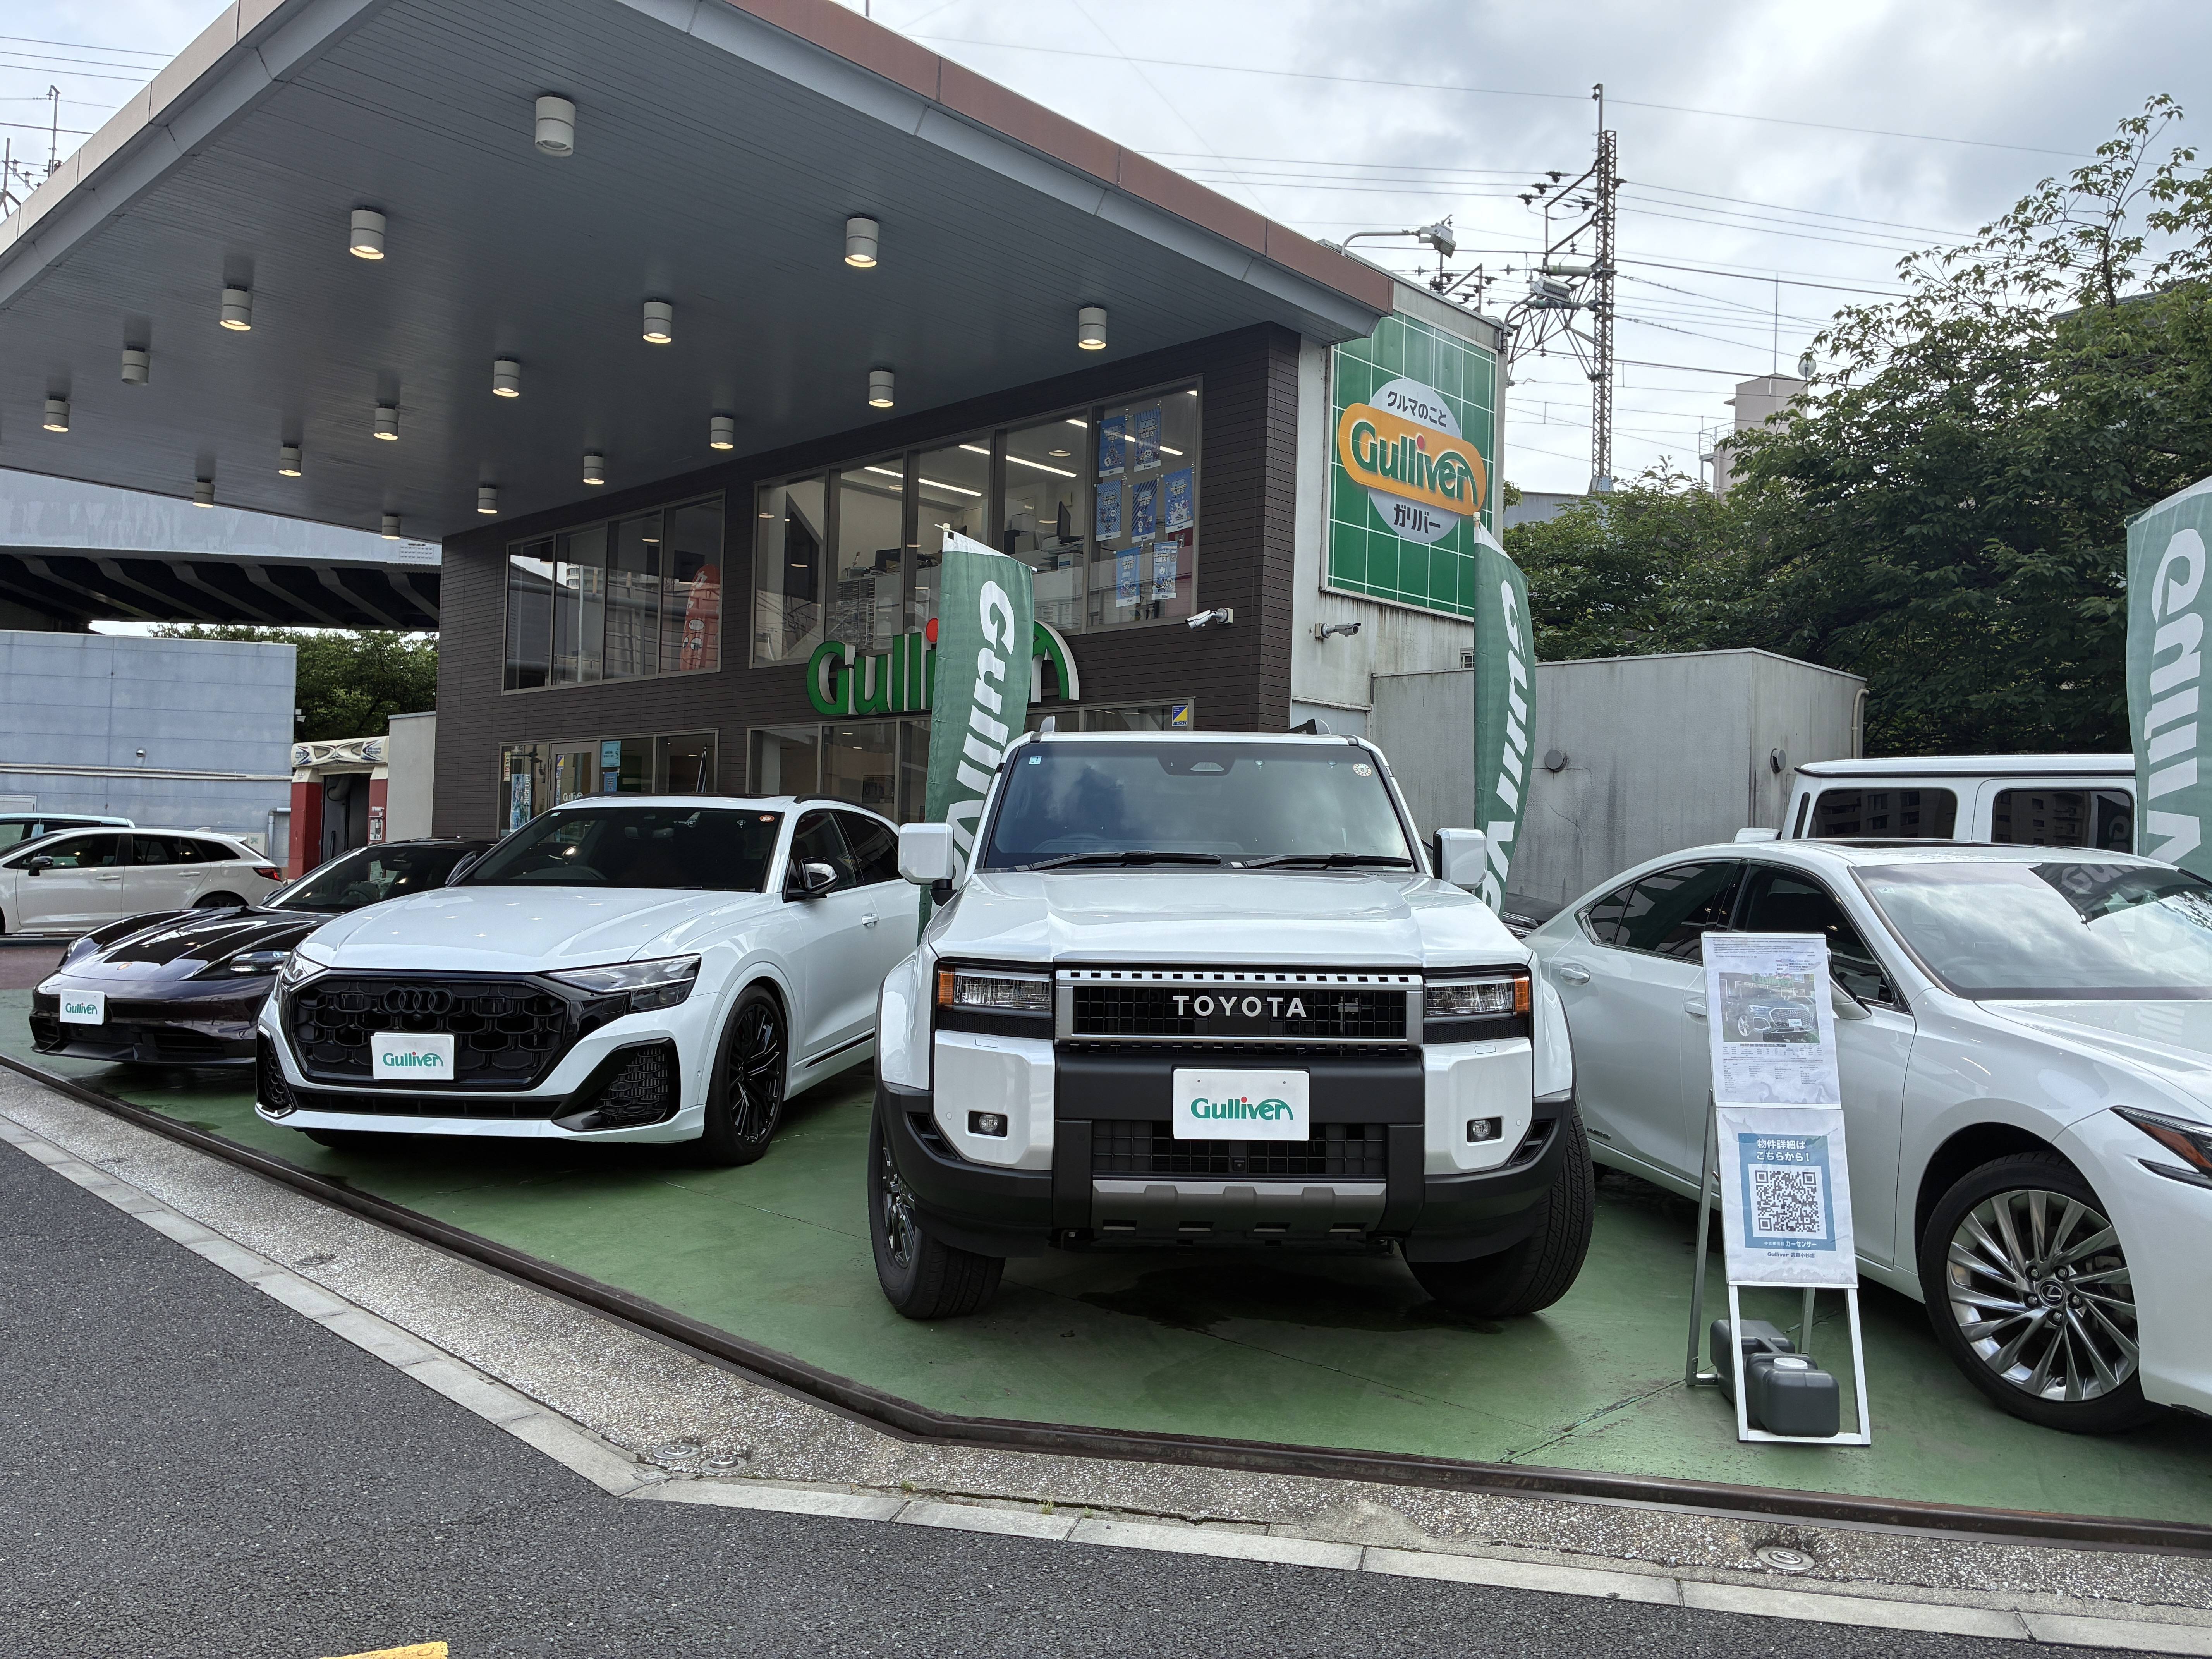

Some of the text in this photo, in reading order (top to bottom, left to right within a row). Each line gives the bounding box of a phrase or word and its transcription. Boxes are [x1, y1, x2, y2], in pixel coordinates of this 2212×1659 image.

[1388, 391, 1446, 427] クルマのこと
[1351, 420, 1478, 505] Gulliver
[1394, 503, 1441, 534] ガリバー
[65, 1003, 98, 1015] Gulliver
[1173, 996, 1307, 1017] TOYOTA
[383, 1051, 444, 1067] Gulliver
[1191, 1096, 1293, 1120] Gulliver
[1757, 1139, 1806, 1150] 物件詳細は
